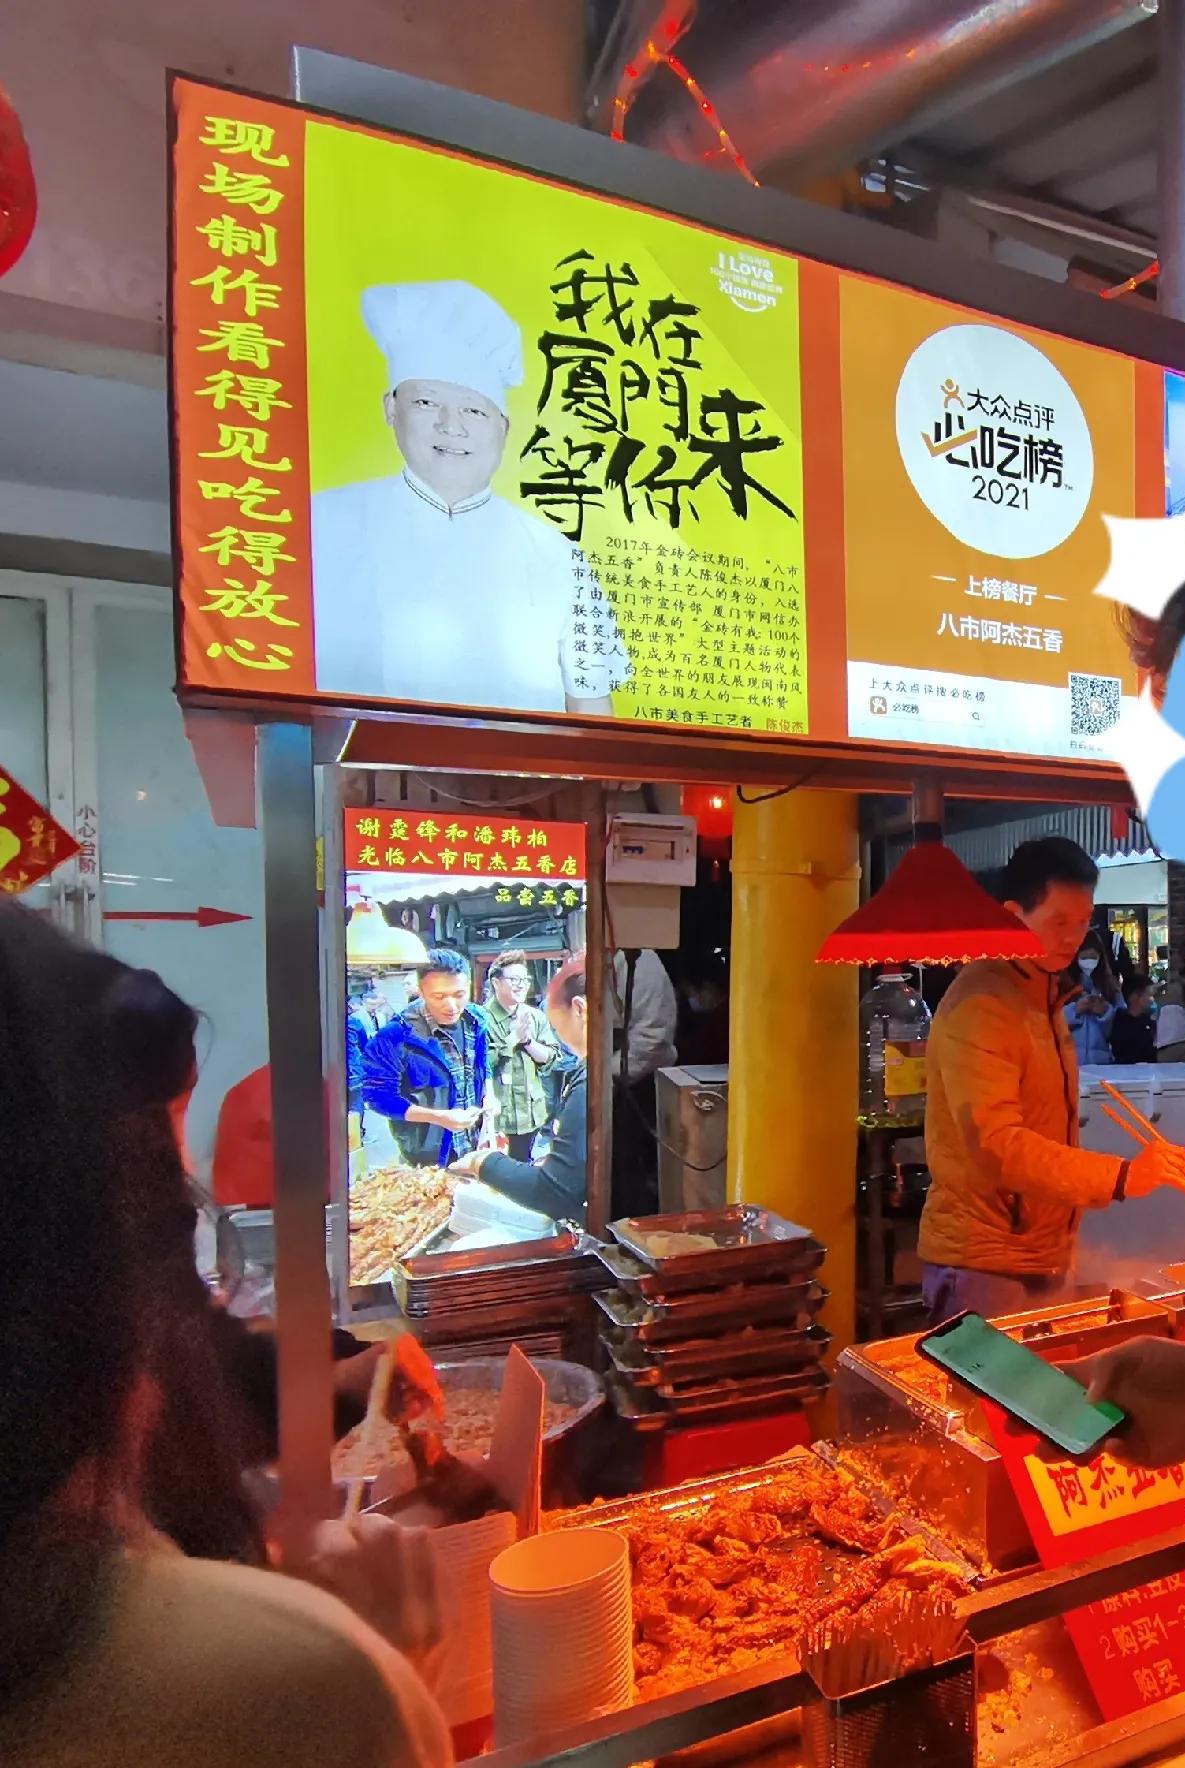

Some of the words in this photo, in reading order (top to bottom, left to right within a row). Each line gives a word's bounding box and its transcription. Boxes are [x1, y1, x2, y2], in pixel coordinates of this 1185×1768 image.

[718, 252, 725, 270] I
[729, 255, 774, 283] Love
[719, 279, 776, 307] Xiamen
[190, 115, 300, 672] 现场制作看得见吃得放心
[967, 388, 1055, 431] 大众点评
[971, 475, 1029, 510] 2021
[963, 575, 1038, 605] 上榜餐厅
[937, 612, 1064, 654] 八市阿杰五香
[868, 677, 987, 703] 上大众点评搜必吃榜
[634, 705, 753, 728] 八市美食手工艺者
[356, 818, 547, 848] 谢霆锋和潘玮柏
[357, 845, 578, 876] 光临八市阿杰五香店
[1132, 1658, 1180, 1702] 购买
